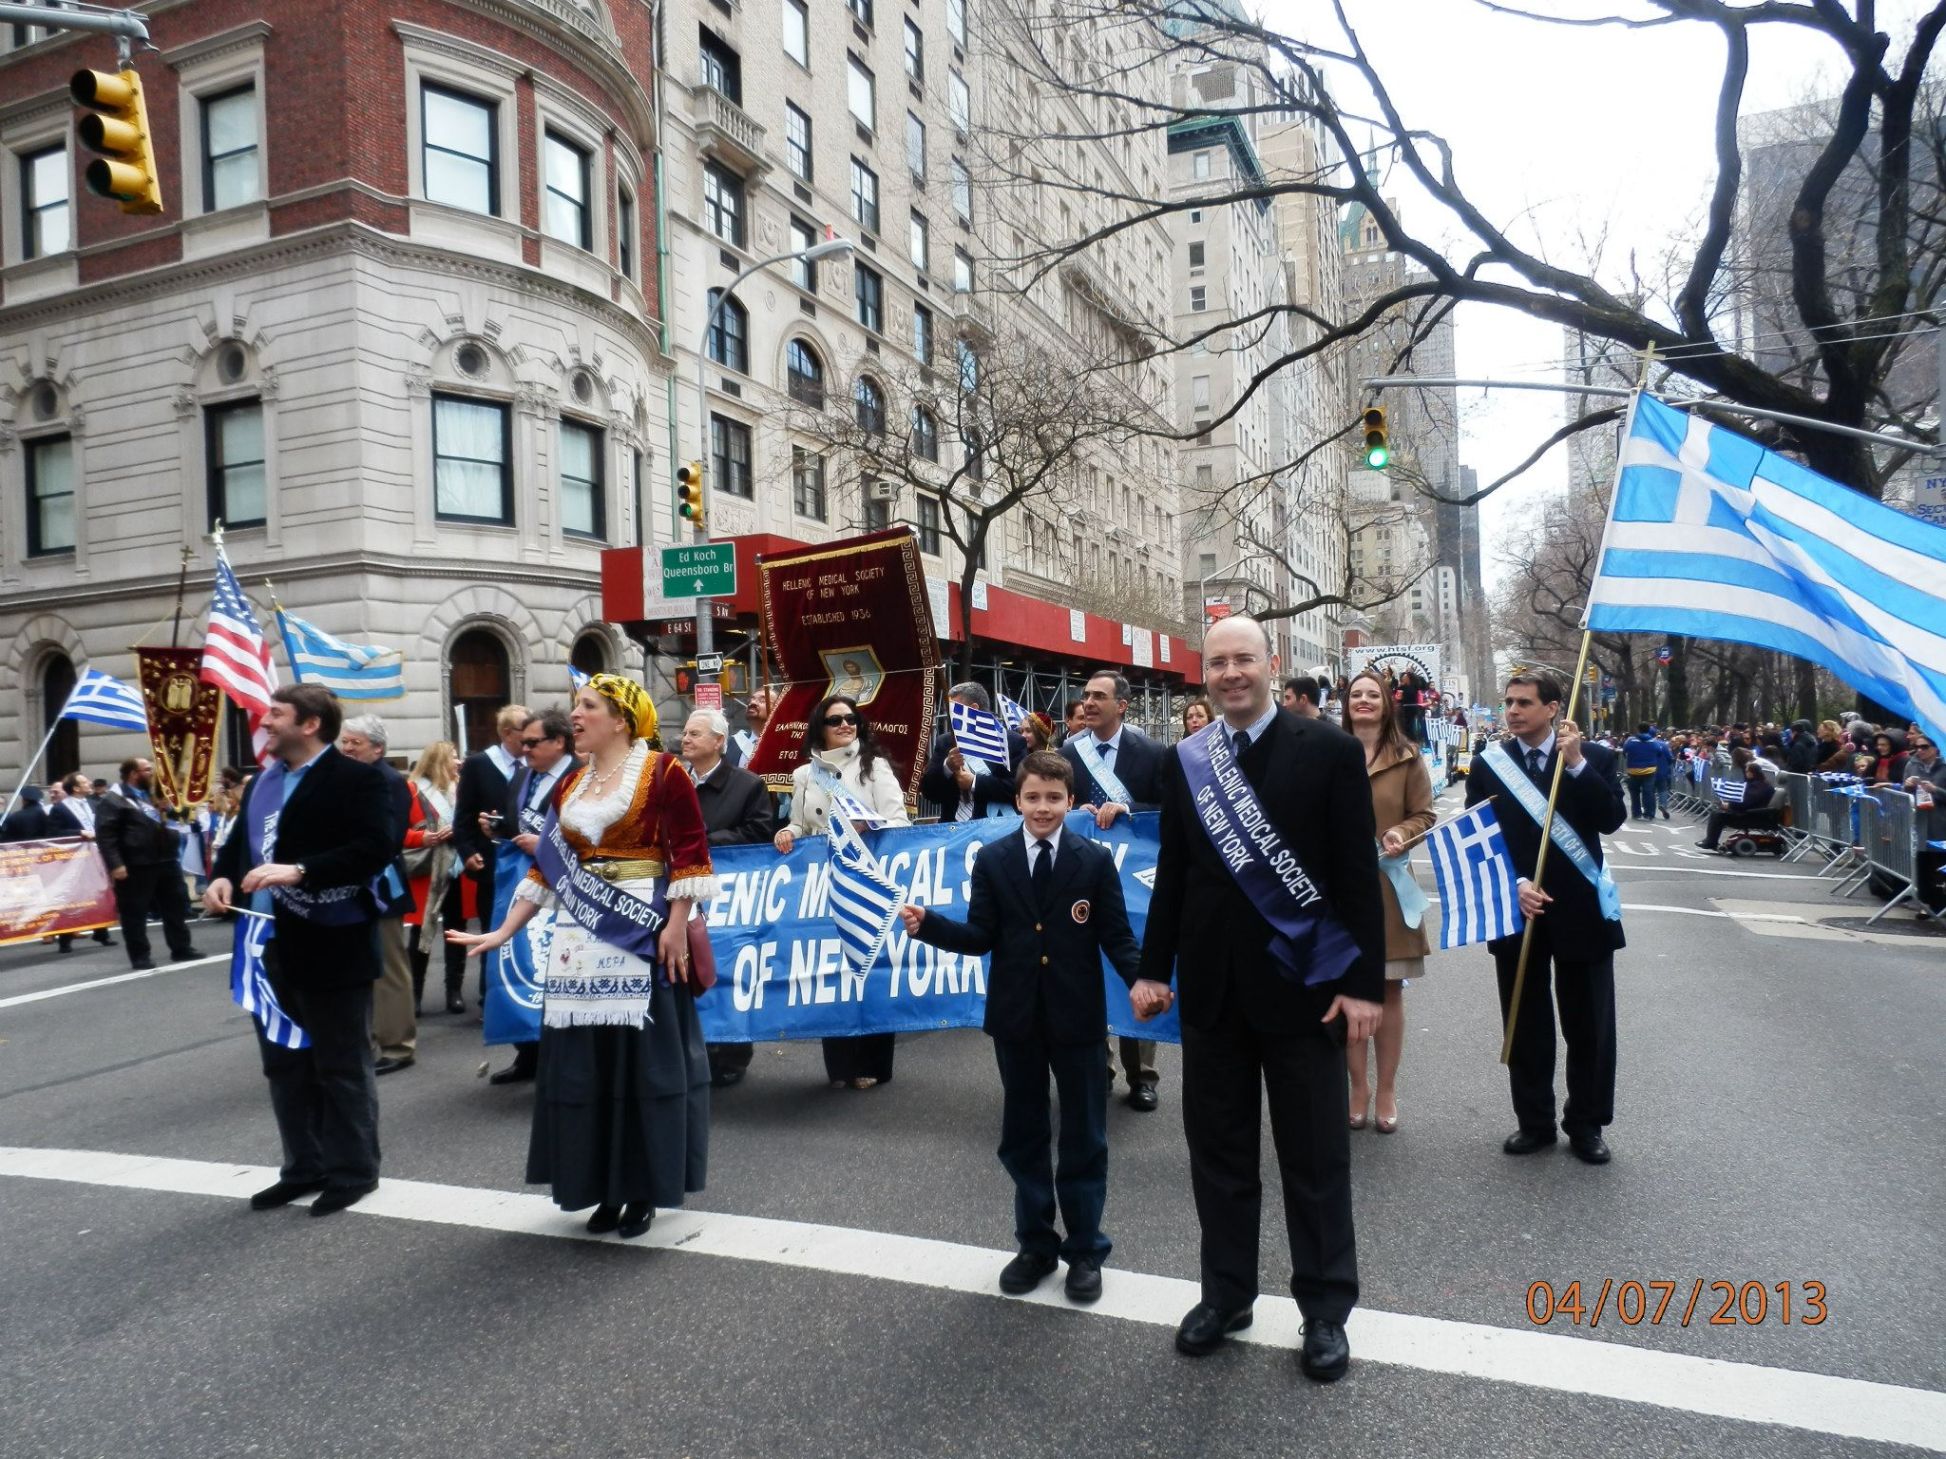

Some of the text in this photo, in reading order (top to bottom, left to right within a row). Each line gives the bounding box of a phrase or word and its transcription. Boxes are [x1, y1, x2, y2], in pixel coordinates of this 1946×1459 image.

[678, 549, 717, 563] Ed Koch
[663, 562, 734, 579] Queensboro Br
[782, 567, 885, 591] HELLENIC MEDICAL SOCIETY
[806, 584, 860, 600] OF NEW YORK
[801, 608, 871, 626] ESTABLISHED 1936
[667, 622, 692, 634] E 64 St
[1354, 645, 1435, 654] www.htsf.org
[774, 721, 809, 732] ΕΛΛΗΝΙΚΟ
[778, 750, 798, 760] ΕΤΟΣ
[1206, 723, 1322, 907] THE HELLENIC MEDICAL SOCIETY
[1196, 784, 1255, 873] OF NEW YORK
[1563, 837, 1578, 850] OF
[1571, 846, 1588, 862] NY
[555, 874, 568, 893] OF
[573, 899, 604, 931] YORK
[572, 871, 616, 908] MEDICAL
[613, 894, 664, 932] SOCIETY
[704, 864, 792, 927] ENIC
[732, 941, 778, 1012] OF
[886, 929, 987, 998] YORK
